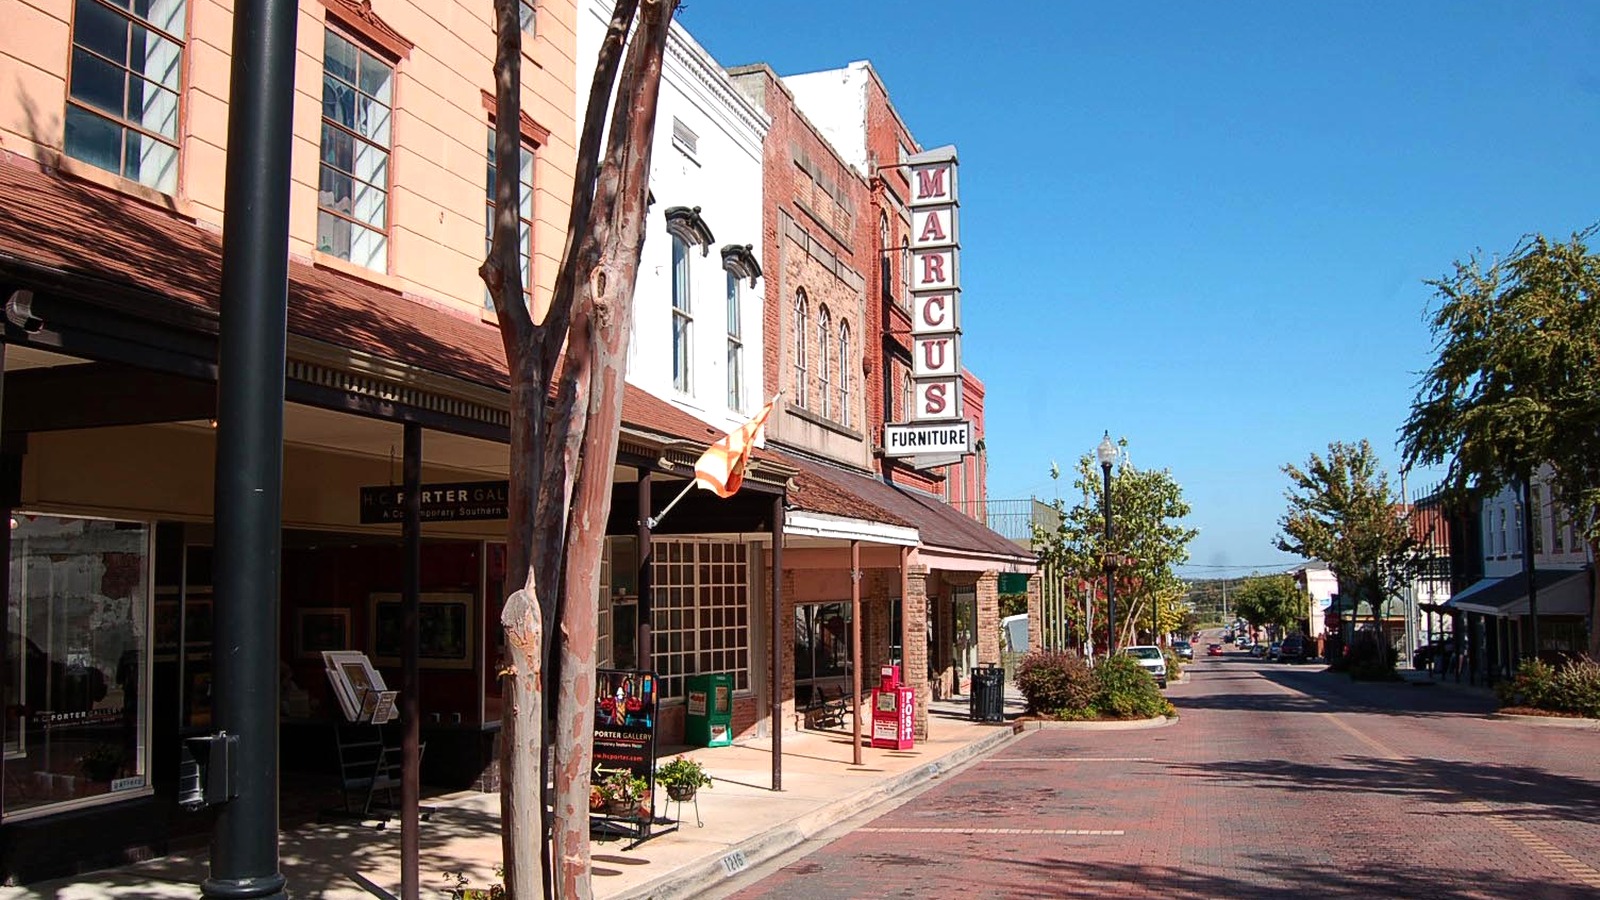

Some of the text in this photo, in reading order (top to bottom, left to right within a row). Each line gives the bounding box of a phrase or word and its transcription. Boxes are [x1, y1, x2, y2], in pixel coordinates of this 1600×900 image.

[917, 168, 948, 415] MARCUS
[892, 429, 966, 447] FURNITURE
[397, 490, 468, 504] PRTER
[459, 506, 501, 517] Southern
[51, 711, 86, 721] PORTER
[905, 691, 913, 740] POST
[594, 730, 621, 739] PORTER
[723, 853, 744, 872] 1216
